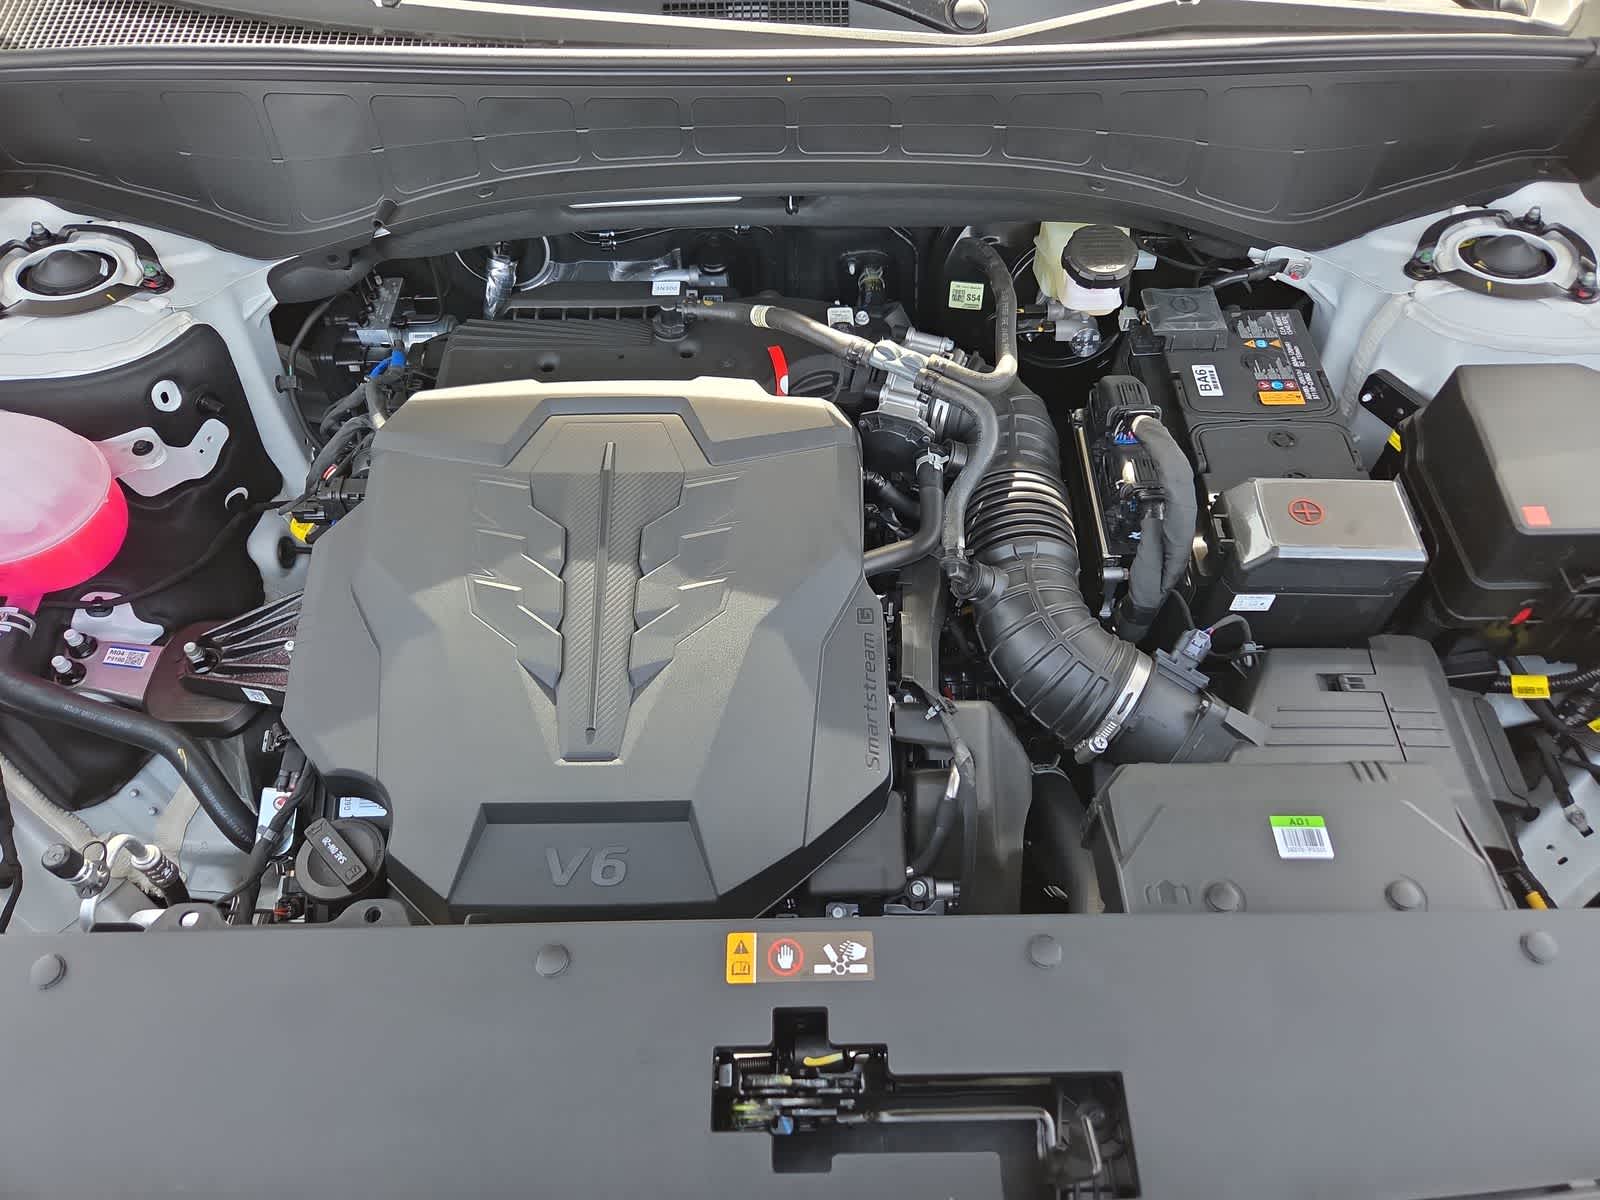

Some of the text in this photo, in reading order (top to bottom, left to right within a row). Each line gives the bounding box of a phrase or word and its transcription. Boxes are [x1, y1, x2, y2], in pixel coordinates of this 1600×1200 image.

[966, 293, 981, 302] S54
[1195, 369, 1213, 391] BA6
[863, 632, 881, 771] Smartstream
[544, 847, 630, 887] V6
